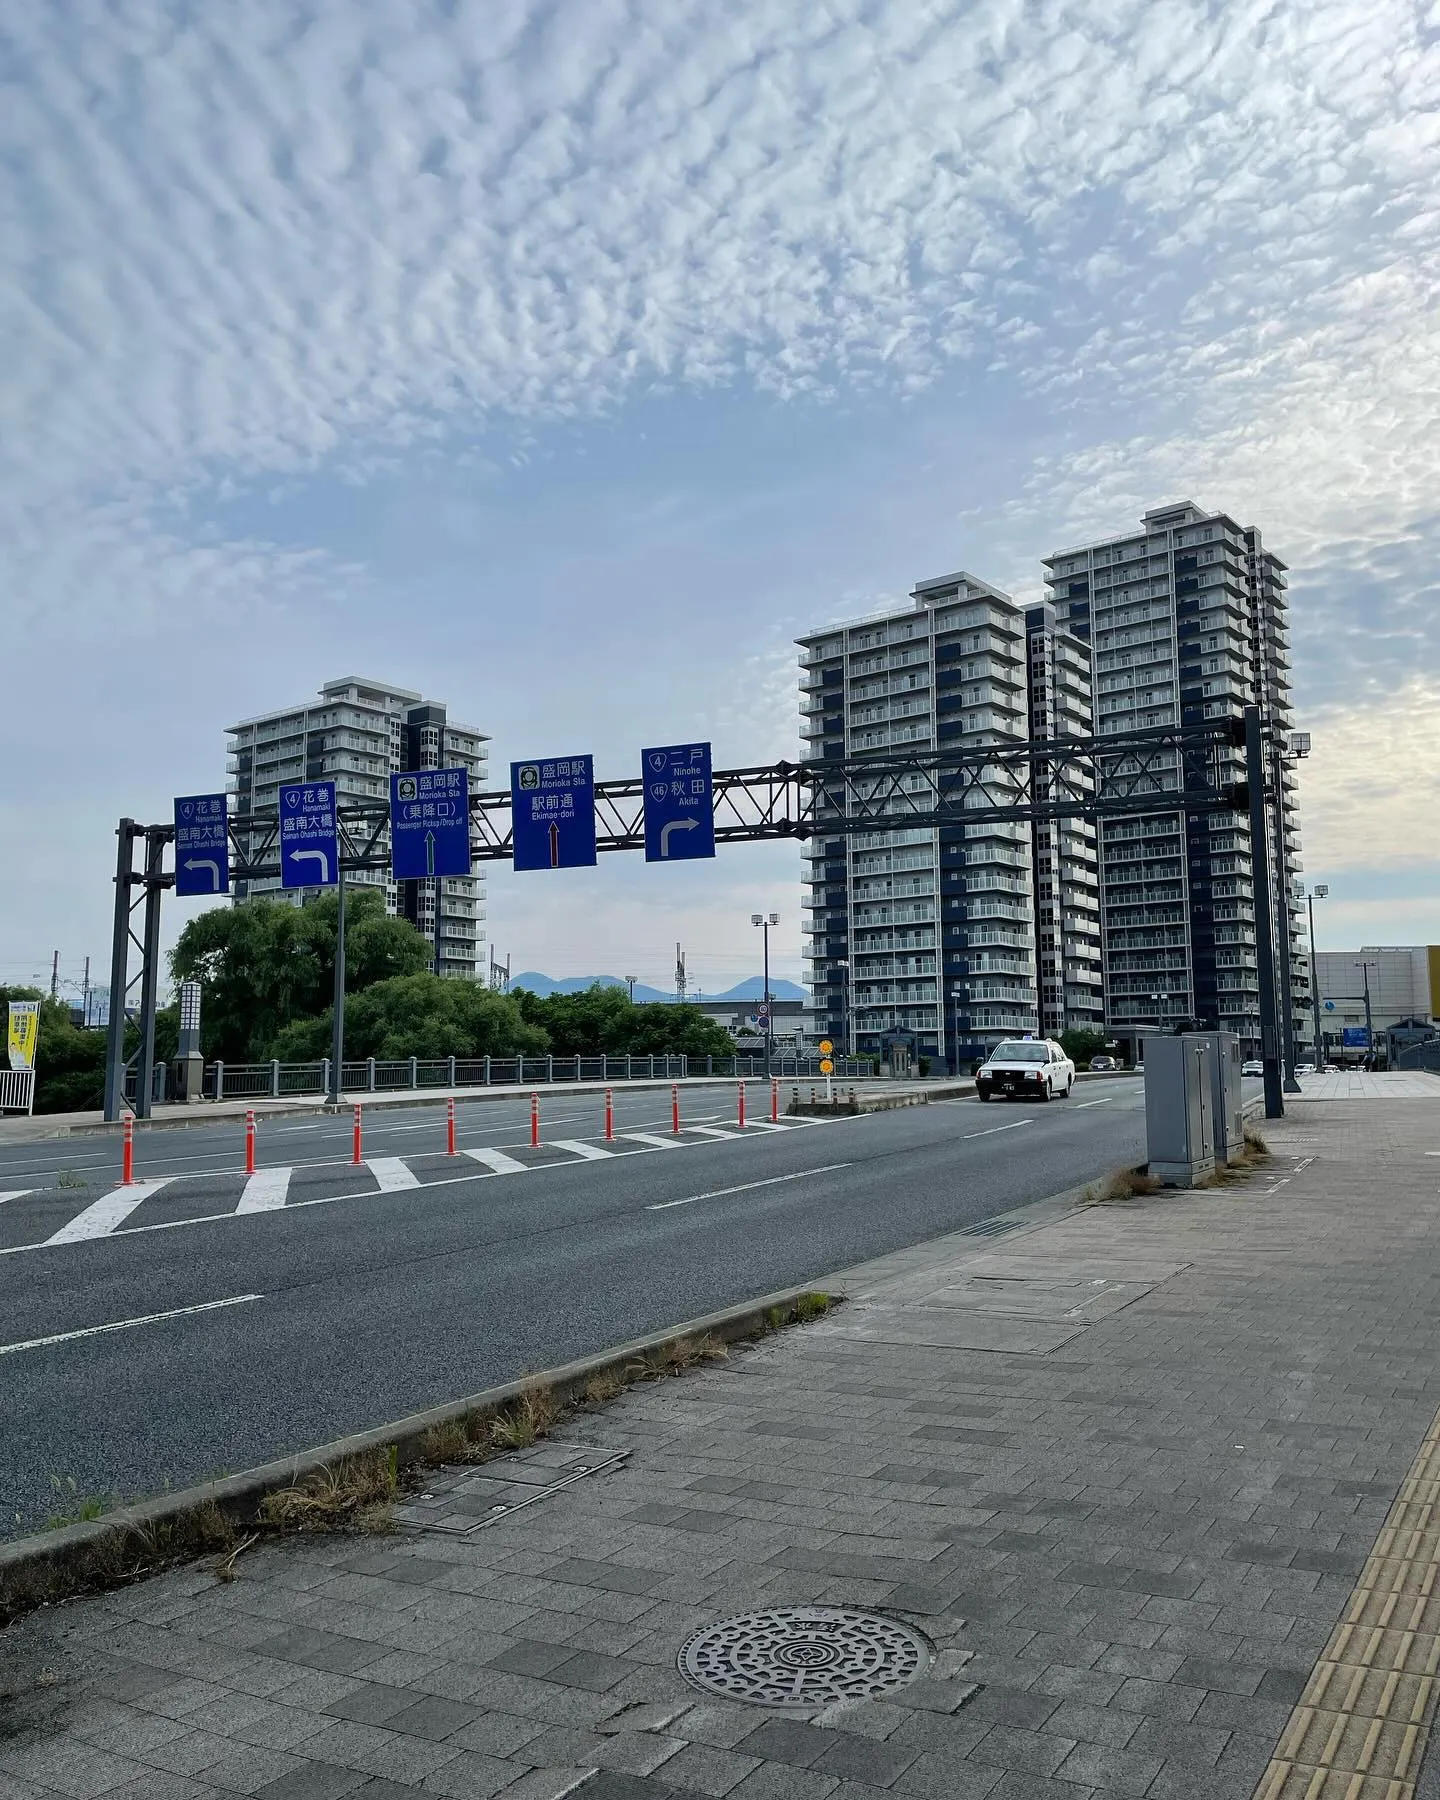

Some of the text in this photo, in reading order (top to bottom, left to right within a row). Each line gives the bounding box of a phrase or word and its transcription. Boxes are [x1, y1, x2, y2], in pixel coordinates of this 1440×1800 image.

[654, 756, 662, 767] 4
[670, 748, 704, 765] 二戸
[542, 761, 586, 778] 盛岡駅
[673, 767, 701, 776] Ninohe
[420, 773, 460, 790] 盛岡駅
[541, 779, 570, 788] Morioka
[671, 780, 704, 796] 秋田
[303, 788, 328, 803] 花巻
[419, 790, 446, 800] Morioka
[654, 786, 664, 796] 46
[290, 794, 296, 804] 4
[532, 793, 574, 811] 駅前通
[196, 800, 221, 814] 花巻
[403, 802, 456, 820] (乗降口)
[284, 814, 332, 831] 盛南大橋
[532, 810, 574, 820] Ekimae-dori
[178, 825, 224, 840] 盛南大橋
